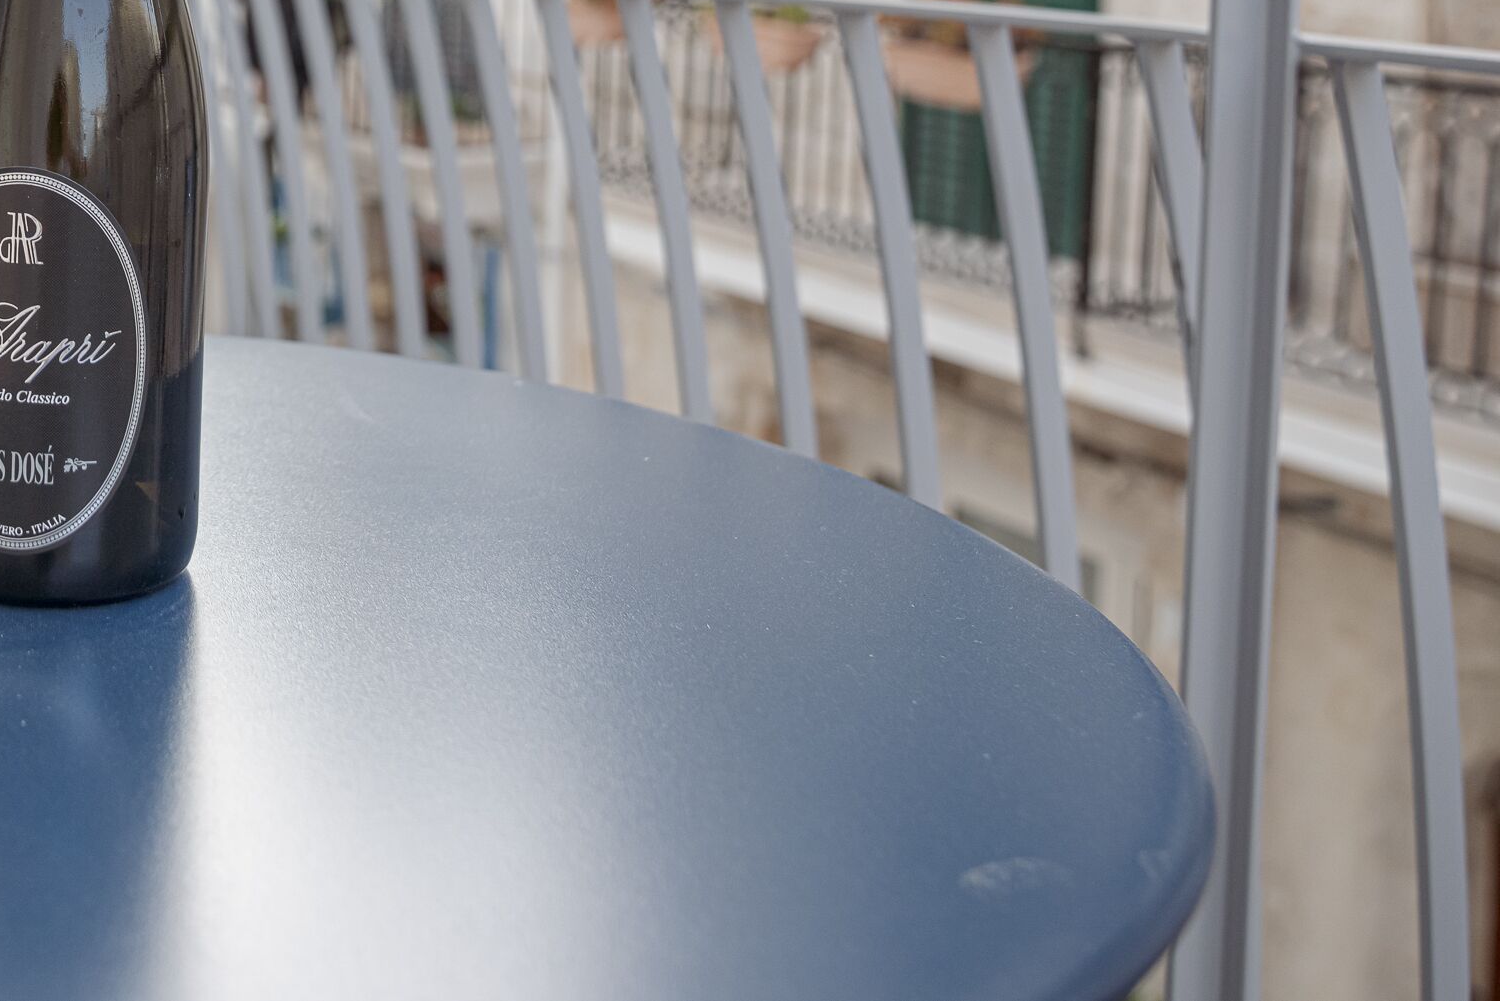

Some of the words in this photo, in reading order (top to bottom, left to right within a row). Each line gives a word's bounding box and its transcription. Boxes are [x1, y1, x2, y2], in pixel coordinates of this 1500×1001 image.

[15, 389, 70, 406] Classico
[10, 444, 55, 486] DOSÉ
[30, 513, 66, 535] ITALIA
